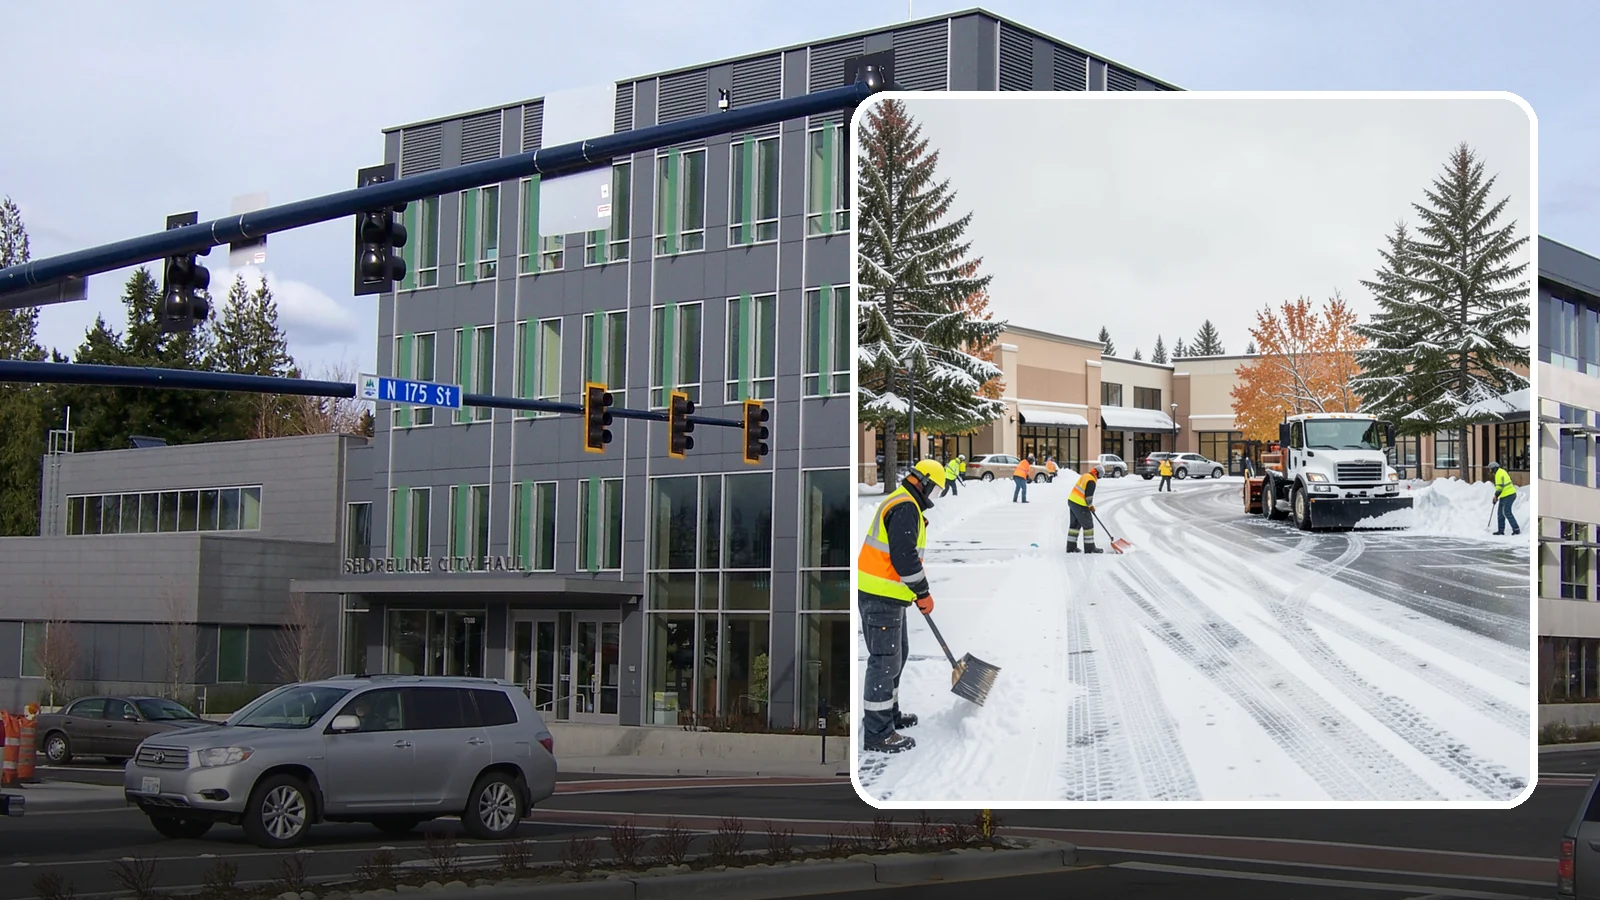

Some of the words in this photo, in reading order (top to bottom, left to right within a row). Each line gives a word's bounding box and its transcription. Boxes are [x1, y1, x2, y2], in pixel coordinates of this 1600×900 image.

[387, 381, 396, 399] N
[405, 383, 428, 402] 175
[436, 387, 451, 405] St
[344, 557, 432, 574] SHORELINE
[438, 556, 475, 572] CITY
[483, 555, 526, 572] HALL
